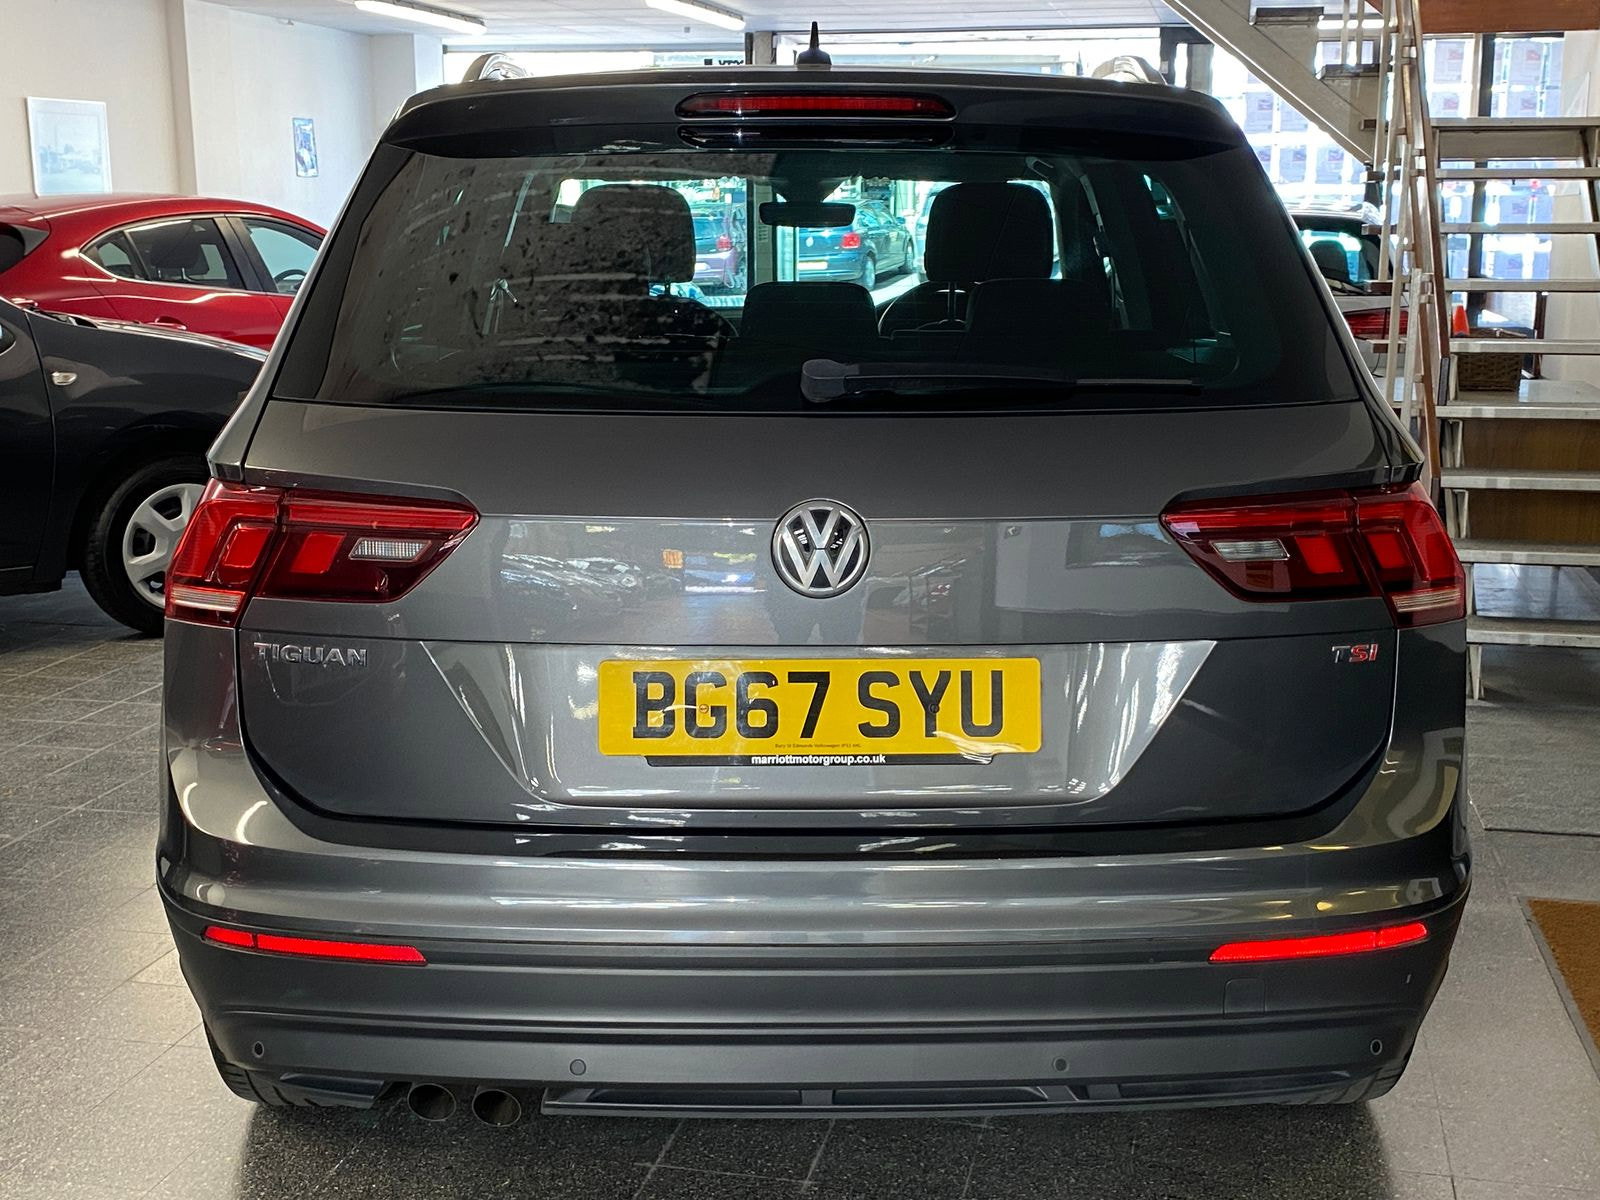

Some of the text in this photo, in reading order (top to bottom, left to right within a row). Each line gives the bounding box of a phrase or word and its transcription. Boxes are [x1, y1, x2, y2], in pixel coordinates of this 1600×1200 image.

[253, 642, 367, 666] TIGUAN
[1331, 644, 1378, 663] TSI
[632, 670, 1004, 739] BG67 SYU
[751, 754, 886, 766] marriottmotorgroup.co.uk
